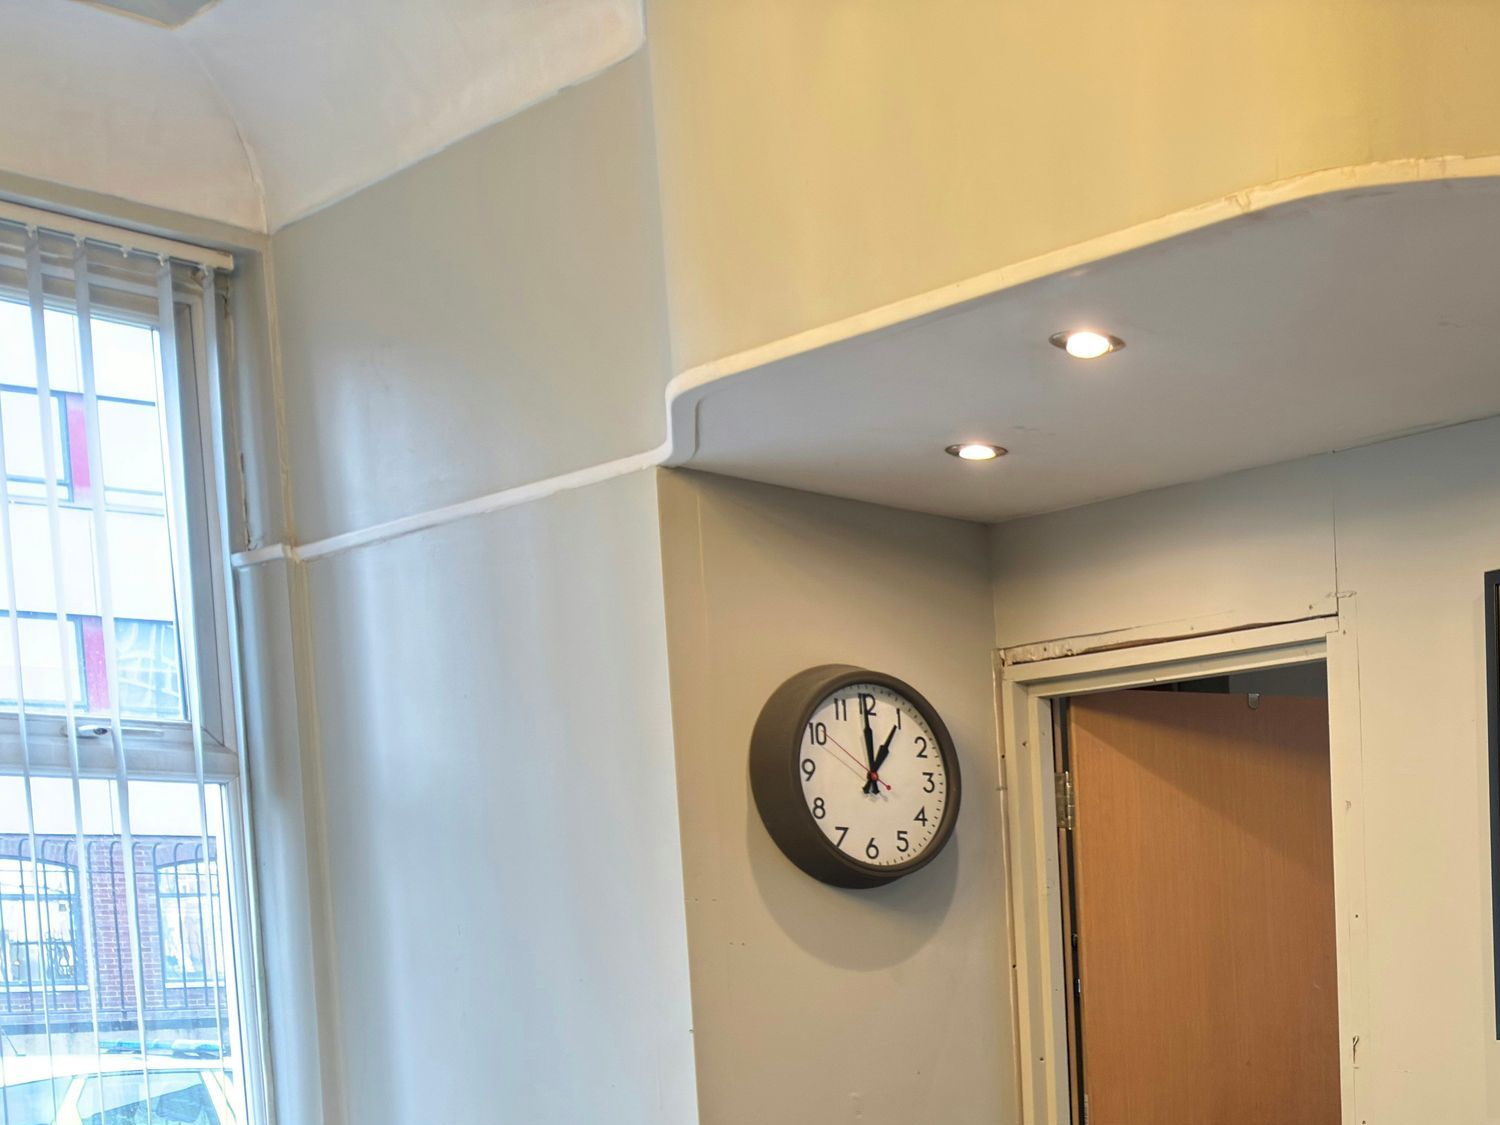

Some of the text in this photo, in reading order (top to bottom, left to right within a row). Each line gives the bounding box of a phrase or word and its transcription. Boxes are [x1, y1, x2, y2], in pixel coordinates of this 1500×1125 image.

[834, 697, 848, 721] 11
[858, 692, 877, 716] 12
[896, 707, 902, 730] 1
[808, 722, 827, 746] 10
[914, 736, 928, 758] 2
[801, 758, 816, 781] 9
[922, 772, 935, 793] 3
[812, 797, 826, 819] 8
[914, 805, 928, 827] 4
[834, 826, 849, 848] 7
[865, 837, 880, 859] 6
[896, 830, 909, 852] 5
